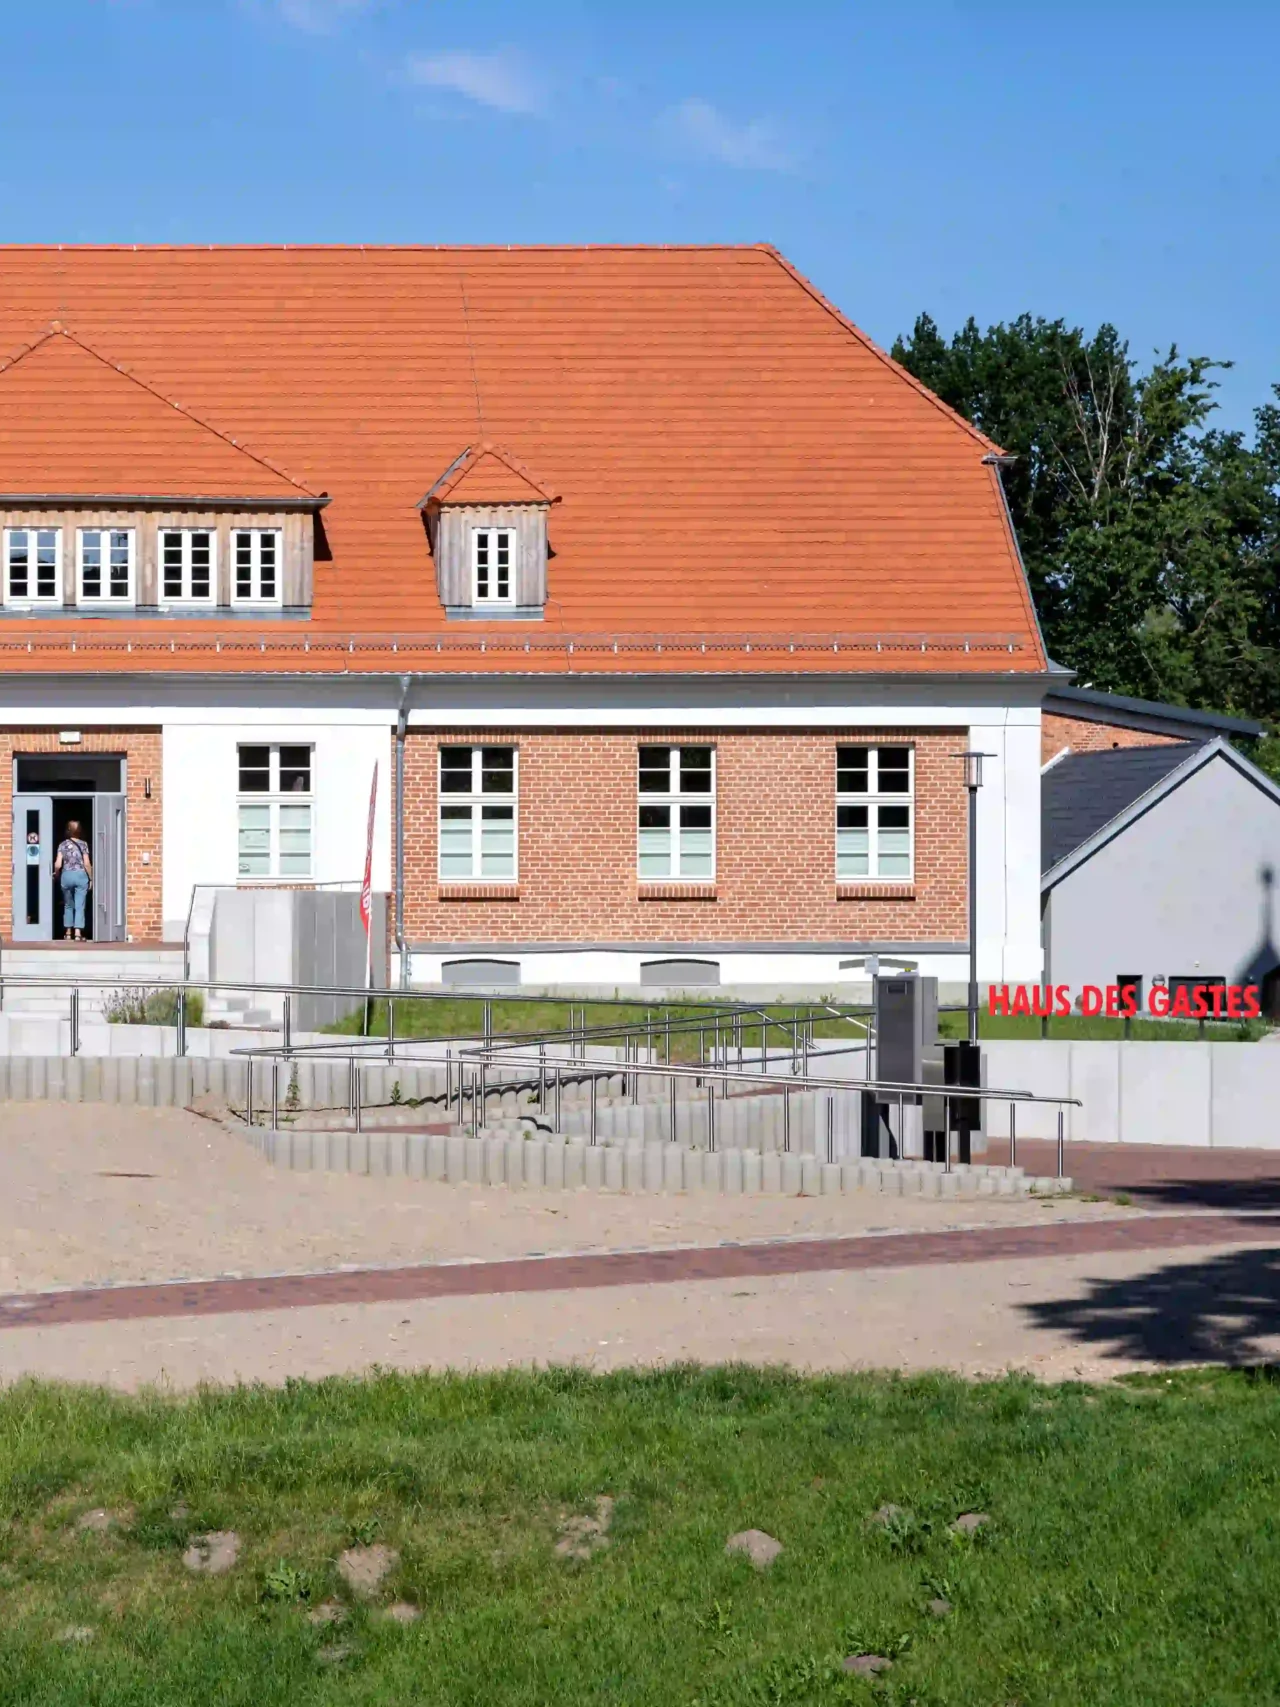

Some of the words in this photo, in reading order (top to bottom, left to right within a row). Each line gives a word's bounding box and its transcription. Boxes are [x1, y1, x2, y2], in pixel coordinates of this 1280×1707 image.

[988, 985, 1070, 1017] HAUS
[1081, 985, 1137, 1018] DES
[1147, 985, 1261, 1018] GASTES
